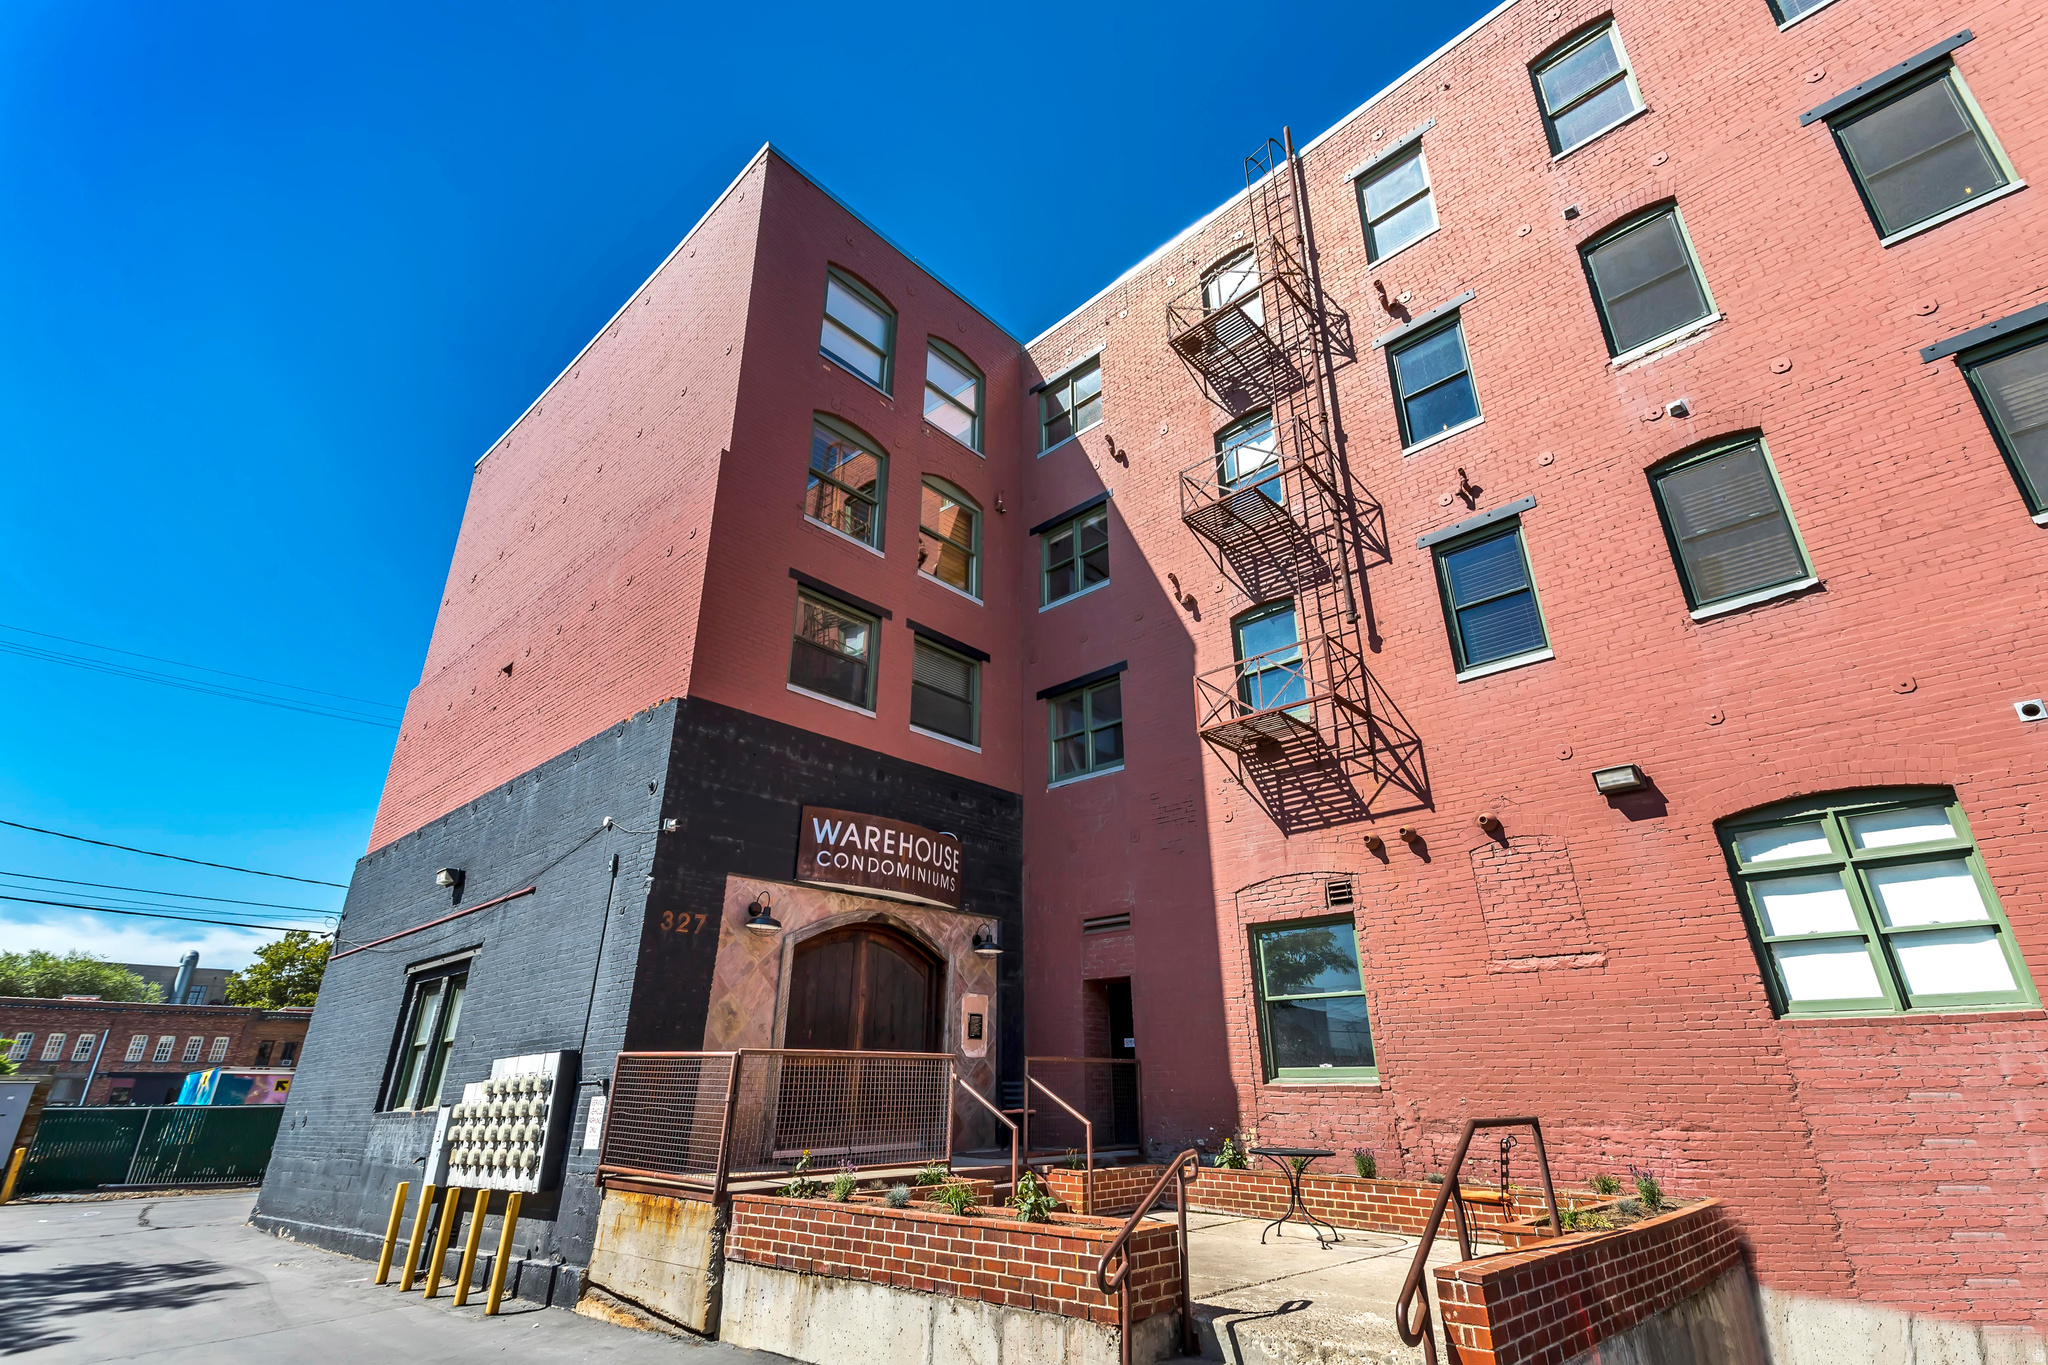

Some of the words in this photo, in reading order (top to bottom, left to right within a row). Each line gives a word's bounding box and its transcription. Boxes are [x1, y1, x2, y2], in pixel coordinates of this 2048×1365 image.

[813, 817, 959, 873] WAREHOUSE
[816, 850, 956, 892] CONDOMINIUMS
[660, 910, 707, 934] 327
